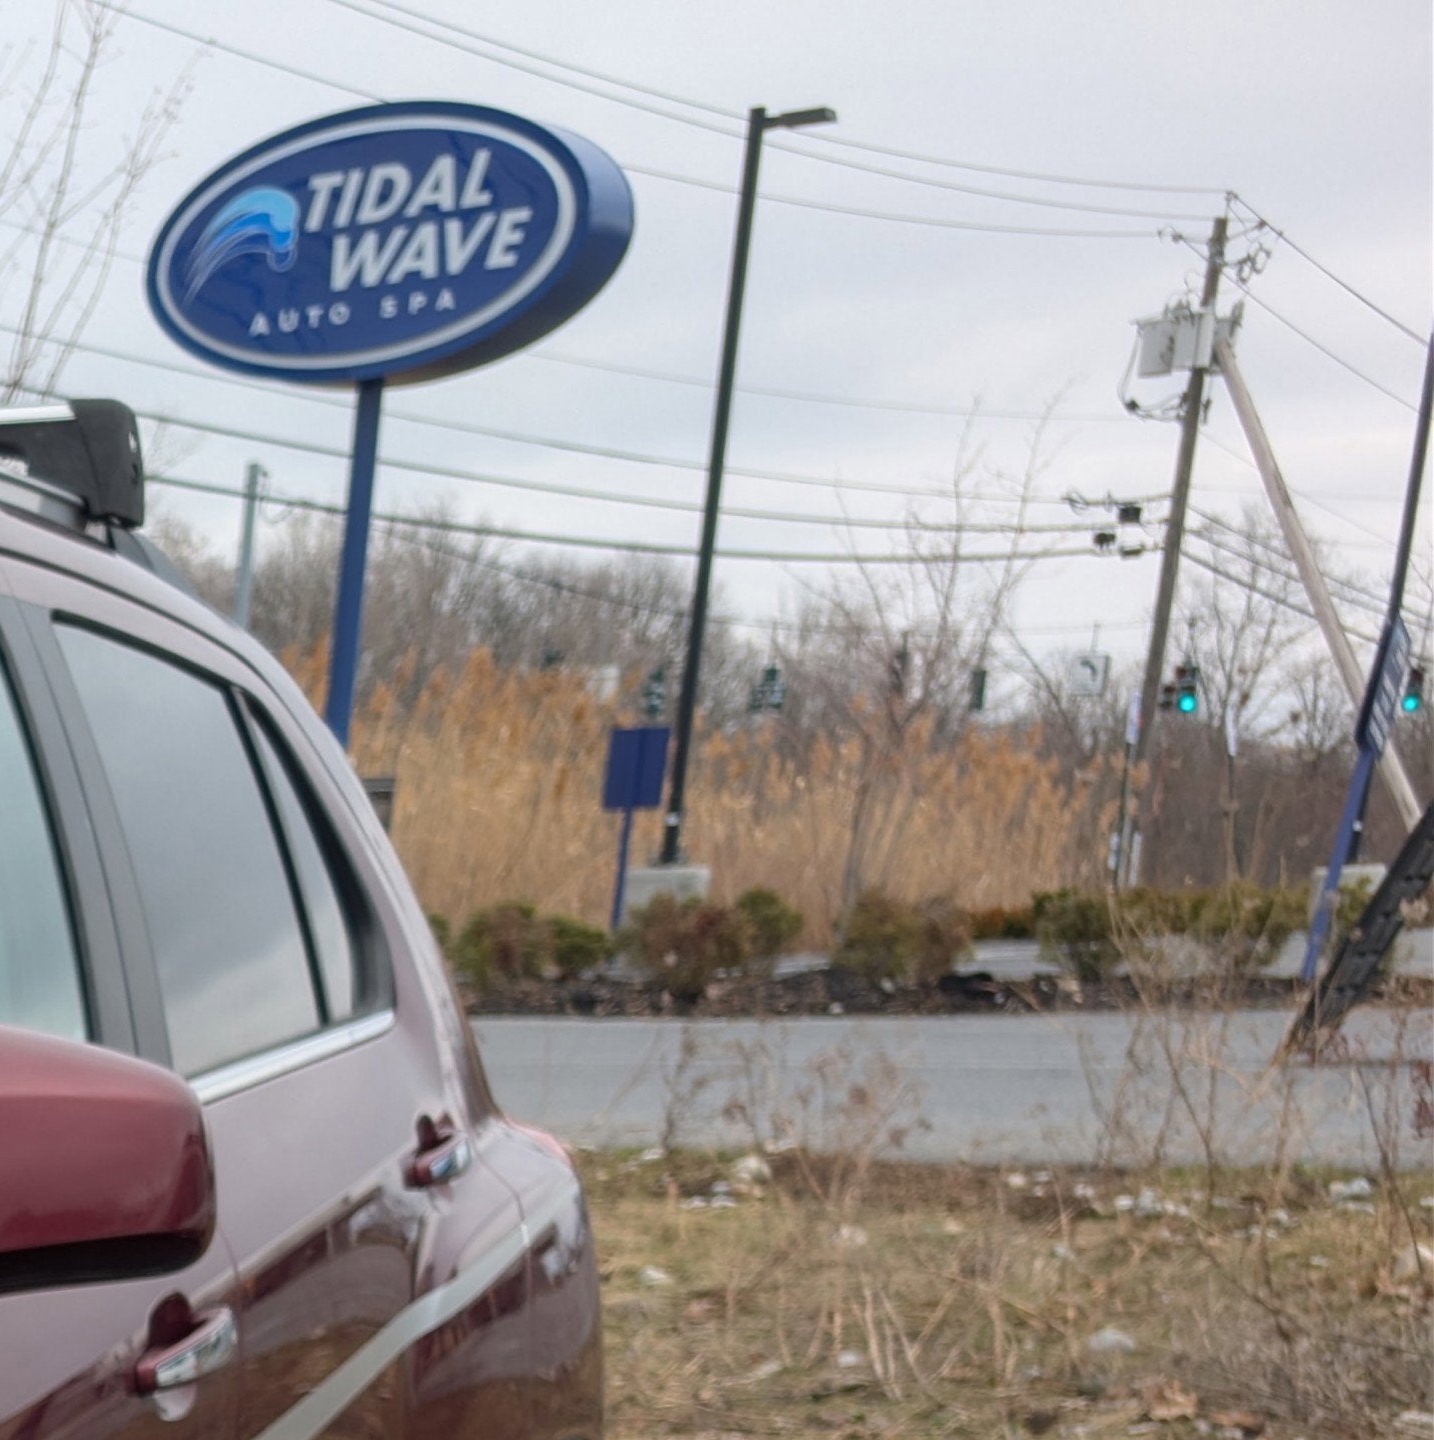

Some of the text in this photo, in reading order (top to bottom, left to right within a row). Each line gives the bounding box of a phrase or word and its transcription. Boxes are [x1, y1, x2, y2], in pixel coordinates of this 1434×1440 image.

[303, 147, 494, 234] TIDAL
[329, 206, 533, 293] WAVE
[249, 288, 457, 337] AUTO SPA
